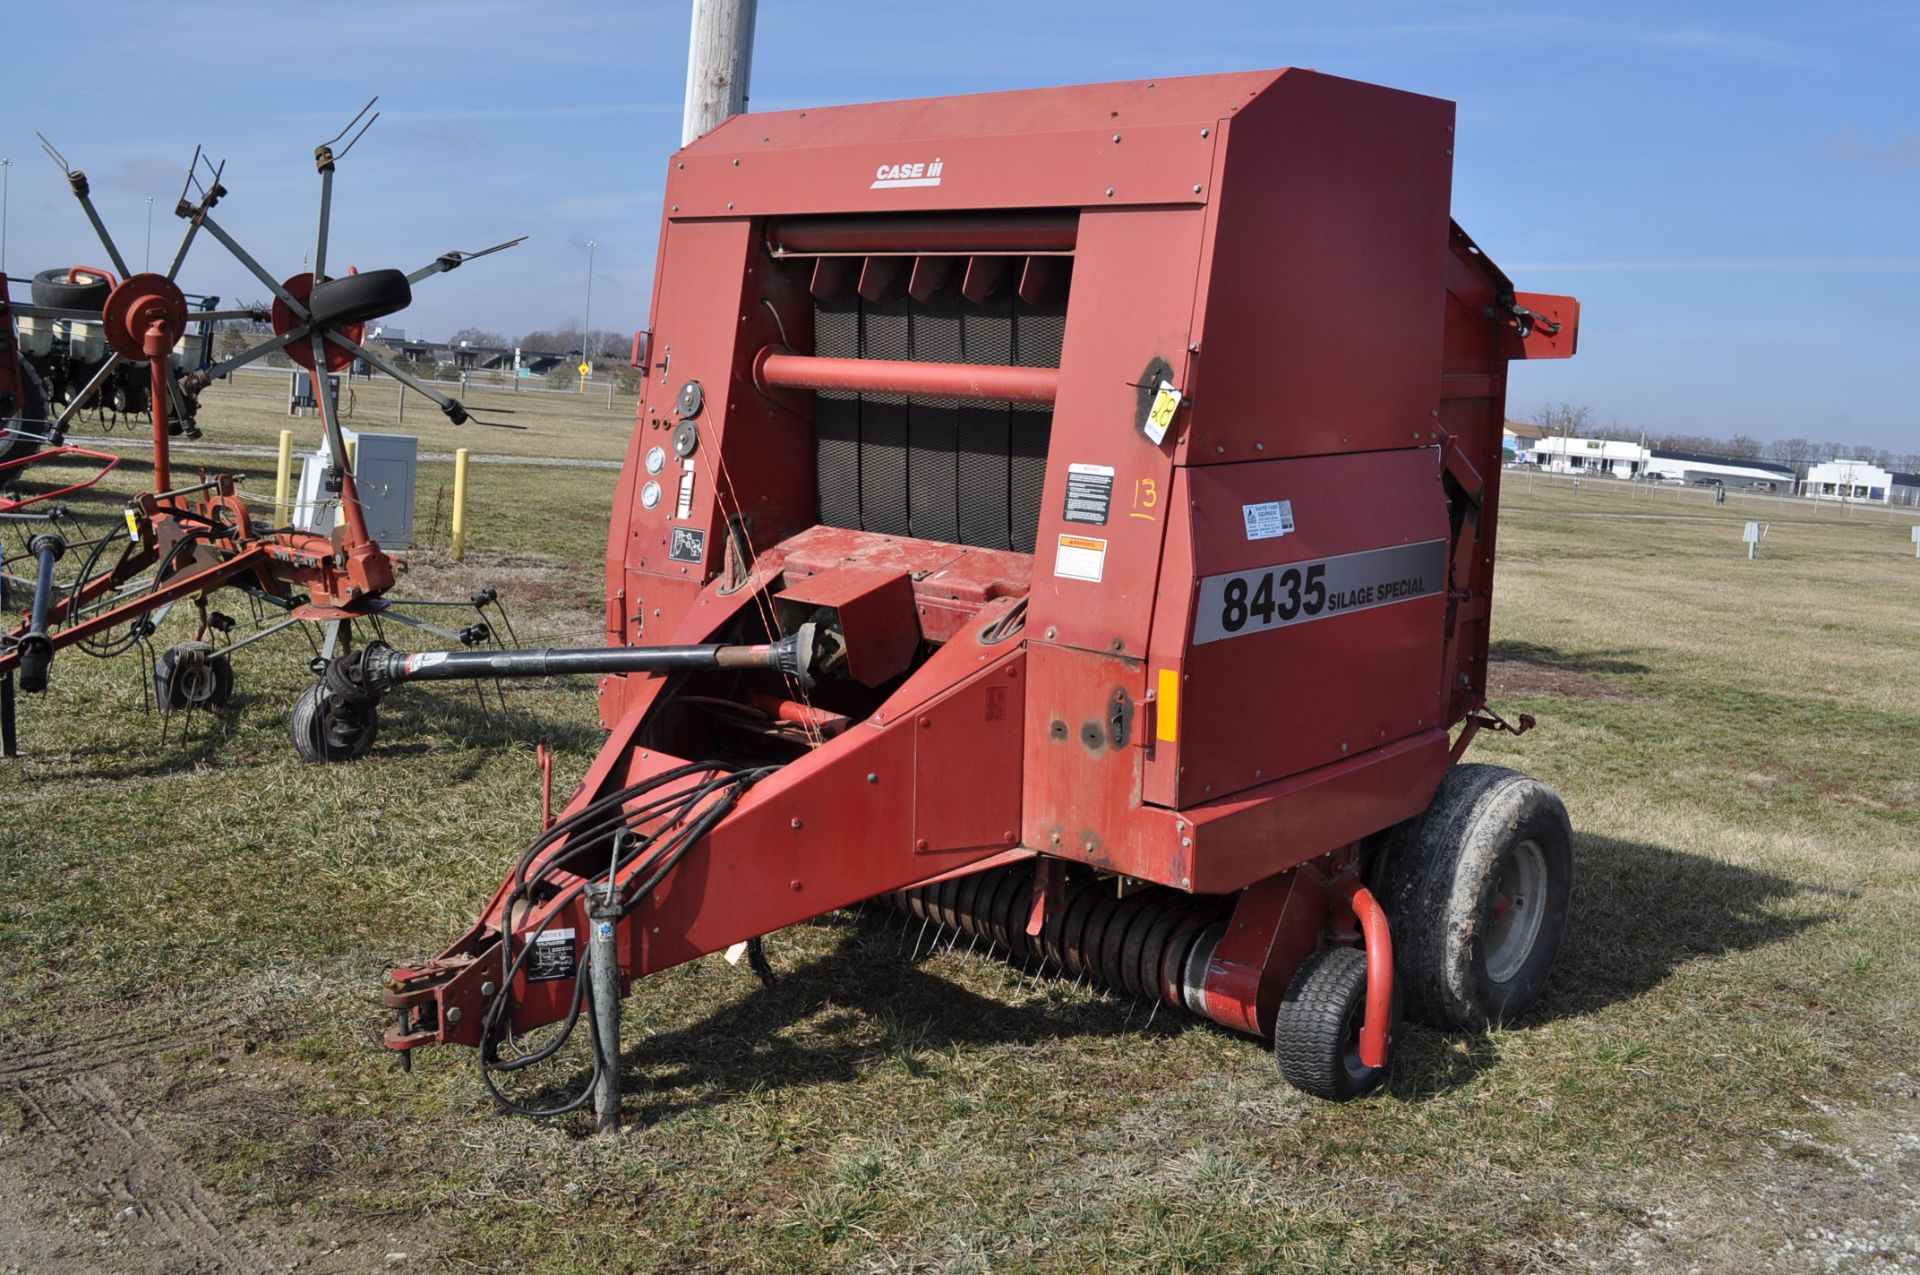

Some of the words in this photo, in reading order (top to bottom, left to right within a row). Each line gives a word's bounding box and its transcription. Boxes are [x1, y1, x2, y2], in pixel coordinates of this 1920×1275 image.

[876, 162, 925, 179] CASE
[1132, 478, 1157, 508] 13
[1221, 564, 1326, 632] 8435
[1328, 586, 1374, 612] SILAGE
[1377, 577, 1425, 602] SPECIAL
